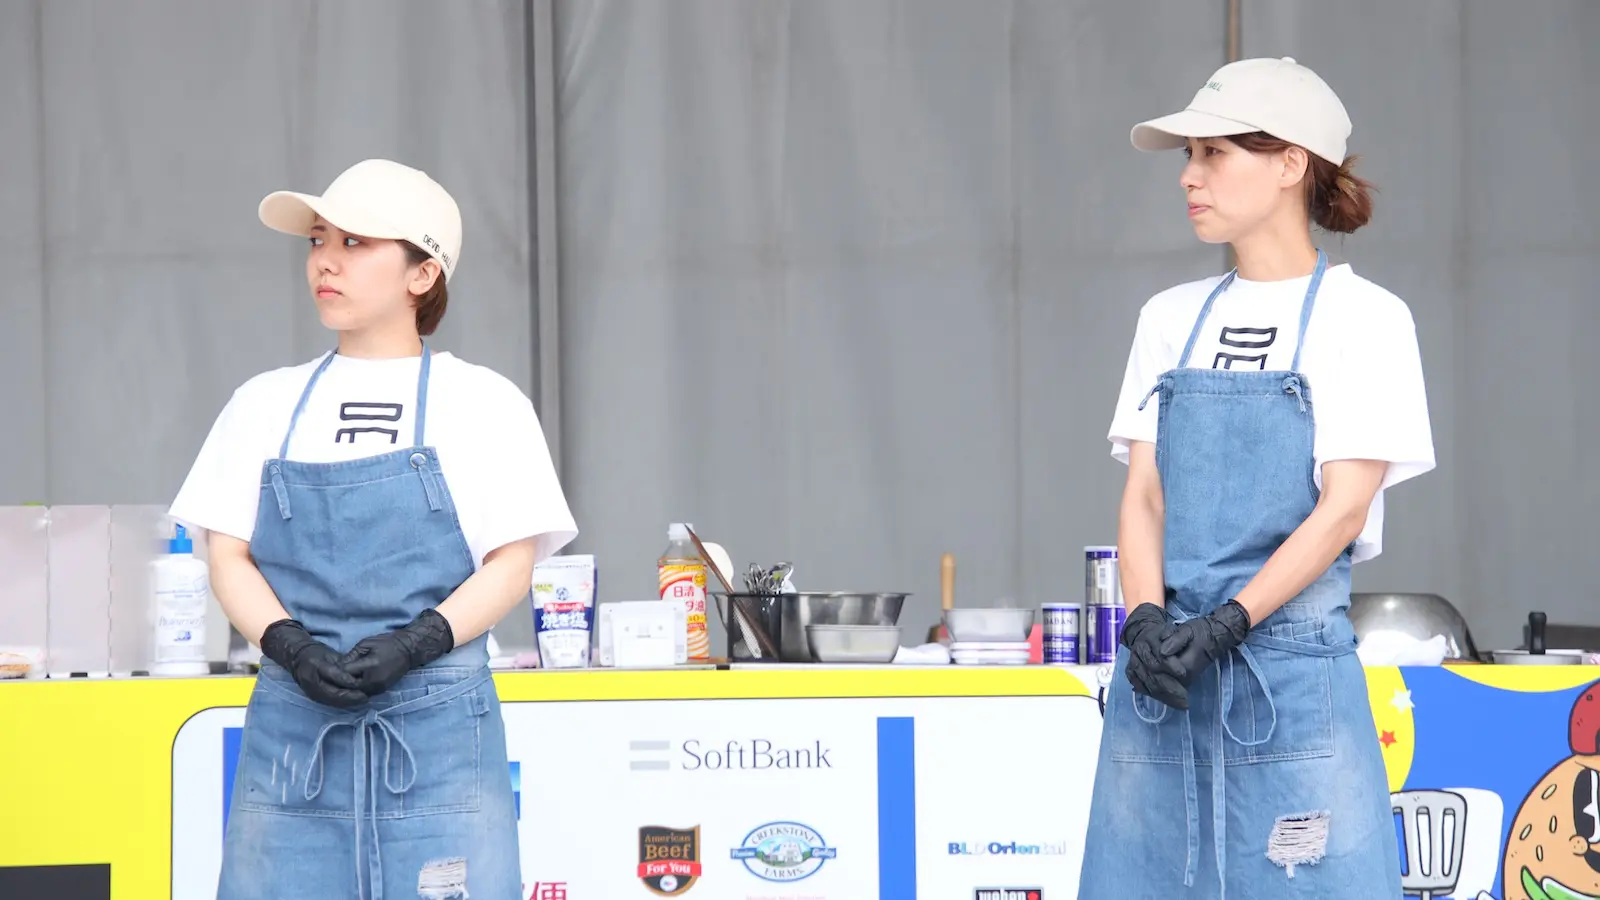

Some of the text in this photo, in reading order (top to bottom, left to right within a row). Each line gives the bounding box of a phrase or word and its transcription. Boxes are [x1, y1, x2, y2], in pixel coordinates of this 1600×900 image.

[422, 234, 441, 254] DEVID
[541, 612, 588, 630] 焼き塩
[682, 738, 833, 772] SoftBank
[644, 833, 692, 843] American
[644, 843, 692, 860] Beef
[646, 863, 692, 875] For You
